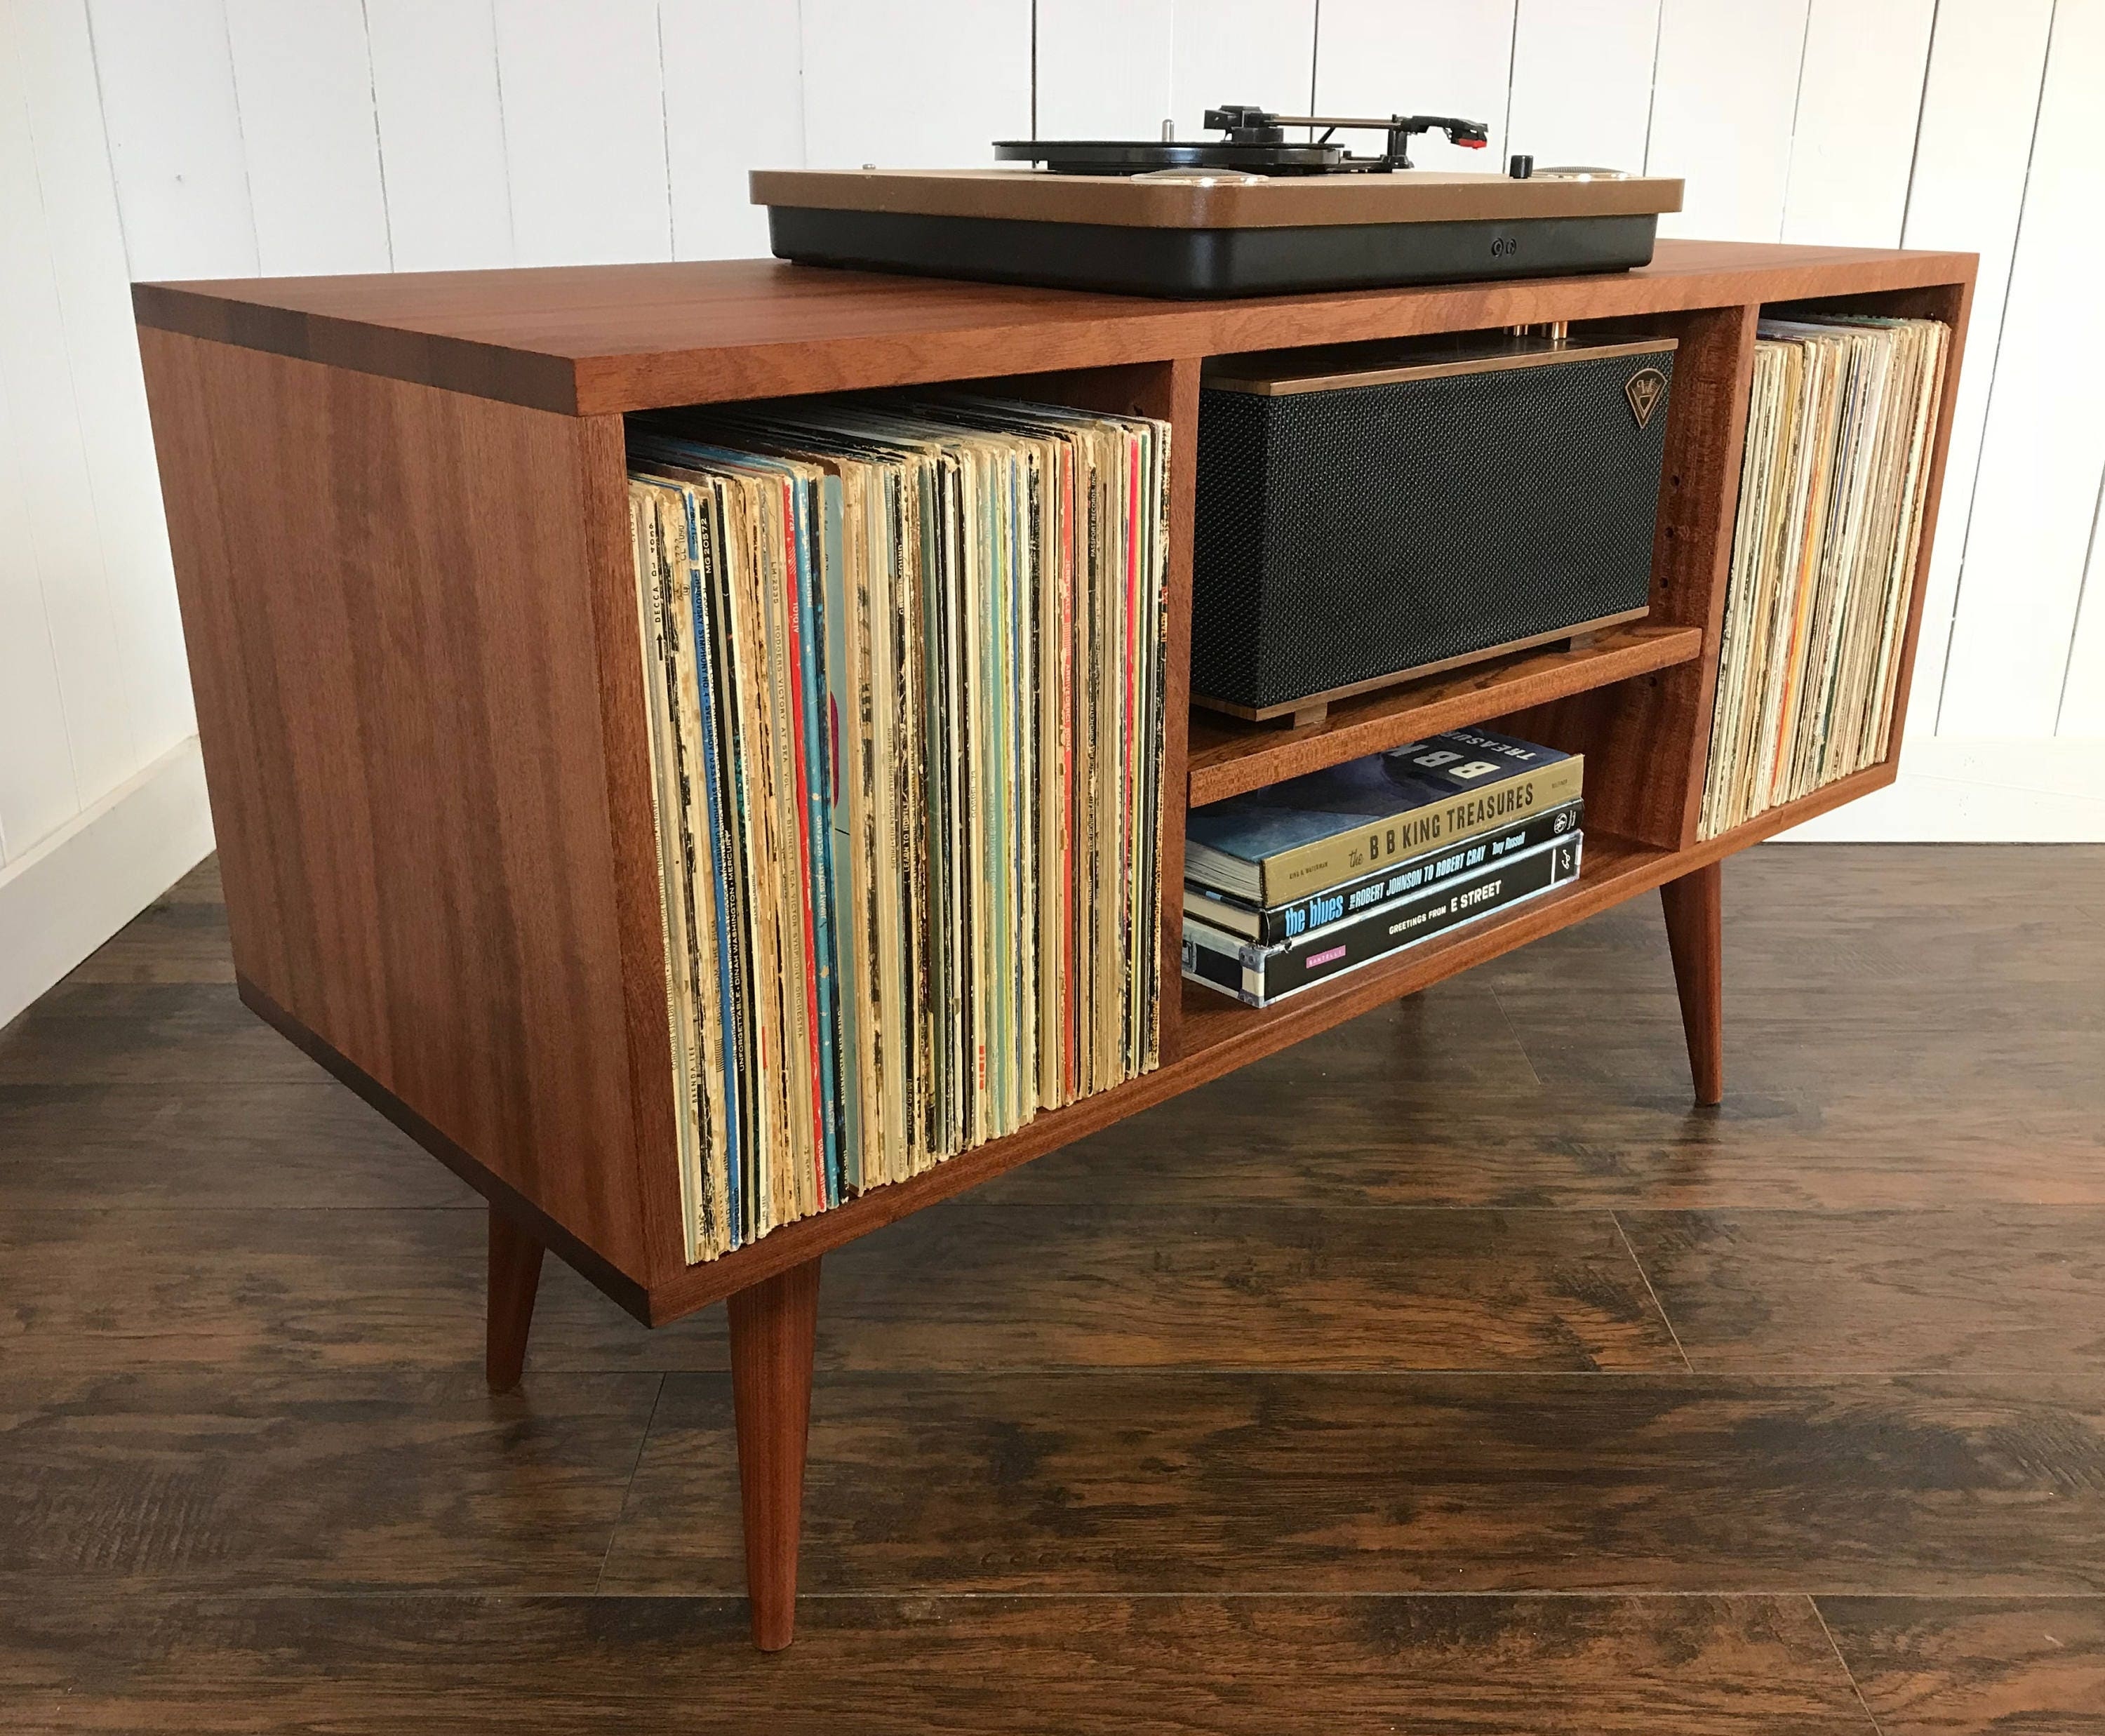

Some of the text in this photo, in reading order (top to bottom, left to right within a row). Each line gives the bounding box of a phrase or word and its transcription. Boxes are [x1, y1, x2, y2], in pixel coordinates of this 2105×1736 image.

[647, 521, 656, 554] 4039
[679, 547, 687, 562] CL
[700, 517, 711, 555] 20572
[704, 556, 712, 574] MG
[652, 585, 661, 623] DECCA
[697, 628, 707, 674] SYMPHONY
[704, 704, 714, 750] SVETLANOV
[1412, 751, 1501, 780] B B
[711, 786, 719, 829] SYMPHONY
[770, 560, 779, 604] LM-2335
[780, 726, 787, 739] AT
[794, 985, 803, 1039] ORCHESTRA
[815, 813, 824, 857] VOLCANO
[902, 832, 909, 844] TO
[1349, 848, 1365, 868] the
[1370, 834, 1379, 860] B
[1386, 829, 1396, 855] B
[1403, 814, 1441, 849] KING
[1446, 782, 1534, 833] TREASURES
[714, 829, 723, 877] ORCHESTRA
[725, 831, 734, 881] MERCURY
[657, 873, 666, 905] MOTION
[1285, 907, 1306, 937] the
[1309, 894, 1344, 928] blues
[1355, 881, 1385, 908] ROBERT
[1386, 867, 1422, 897] JOHNSON
[1423, 864, 1434, 883] TO
[1435, 852, 1465, 878] ROBERT
[1466, 844, 1487, 867] CRAY
[1492, 841, 1505, 855] Tony
[1504, 831, 1526, 850] Russell
[728, 886, 739, 954] WASHINGTON
[1389, 913, 1426, 935] GREETINGS
[1428, 904, 1447, 919] FROM
[1450, 897, 1458, 913] E
[1460, 879, 1502, 909] STREET
[662, 941, 671, 968] SCORE
[732, 954, 740, 985] DINAH
[664, 973, 674, 1003] UNITED
[667, 1002, 676, 1036] ARTISTS
[714, 996, 723, 1027] MUSIC
[734, 989, 745, 1072] UNFORGETTABLE
[669, 1035, 678, 1071] RECORDS
[689, 1065, 697, 1104] BRENDA
